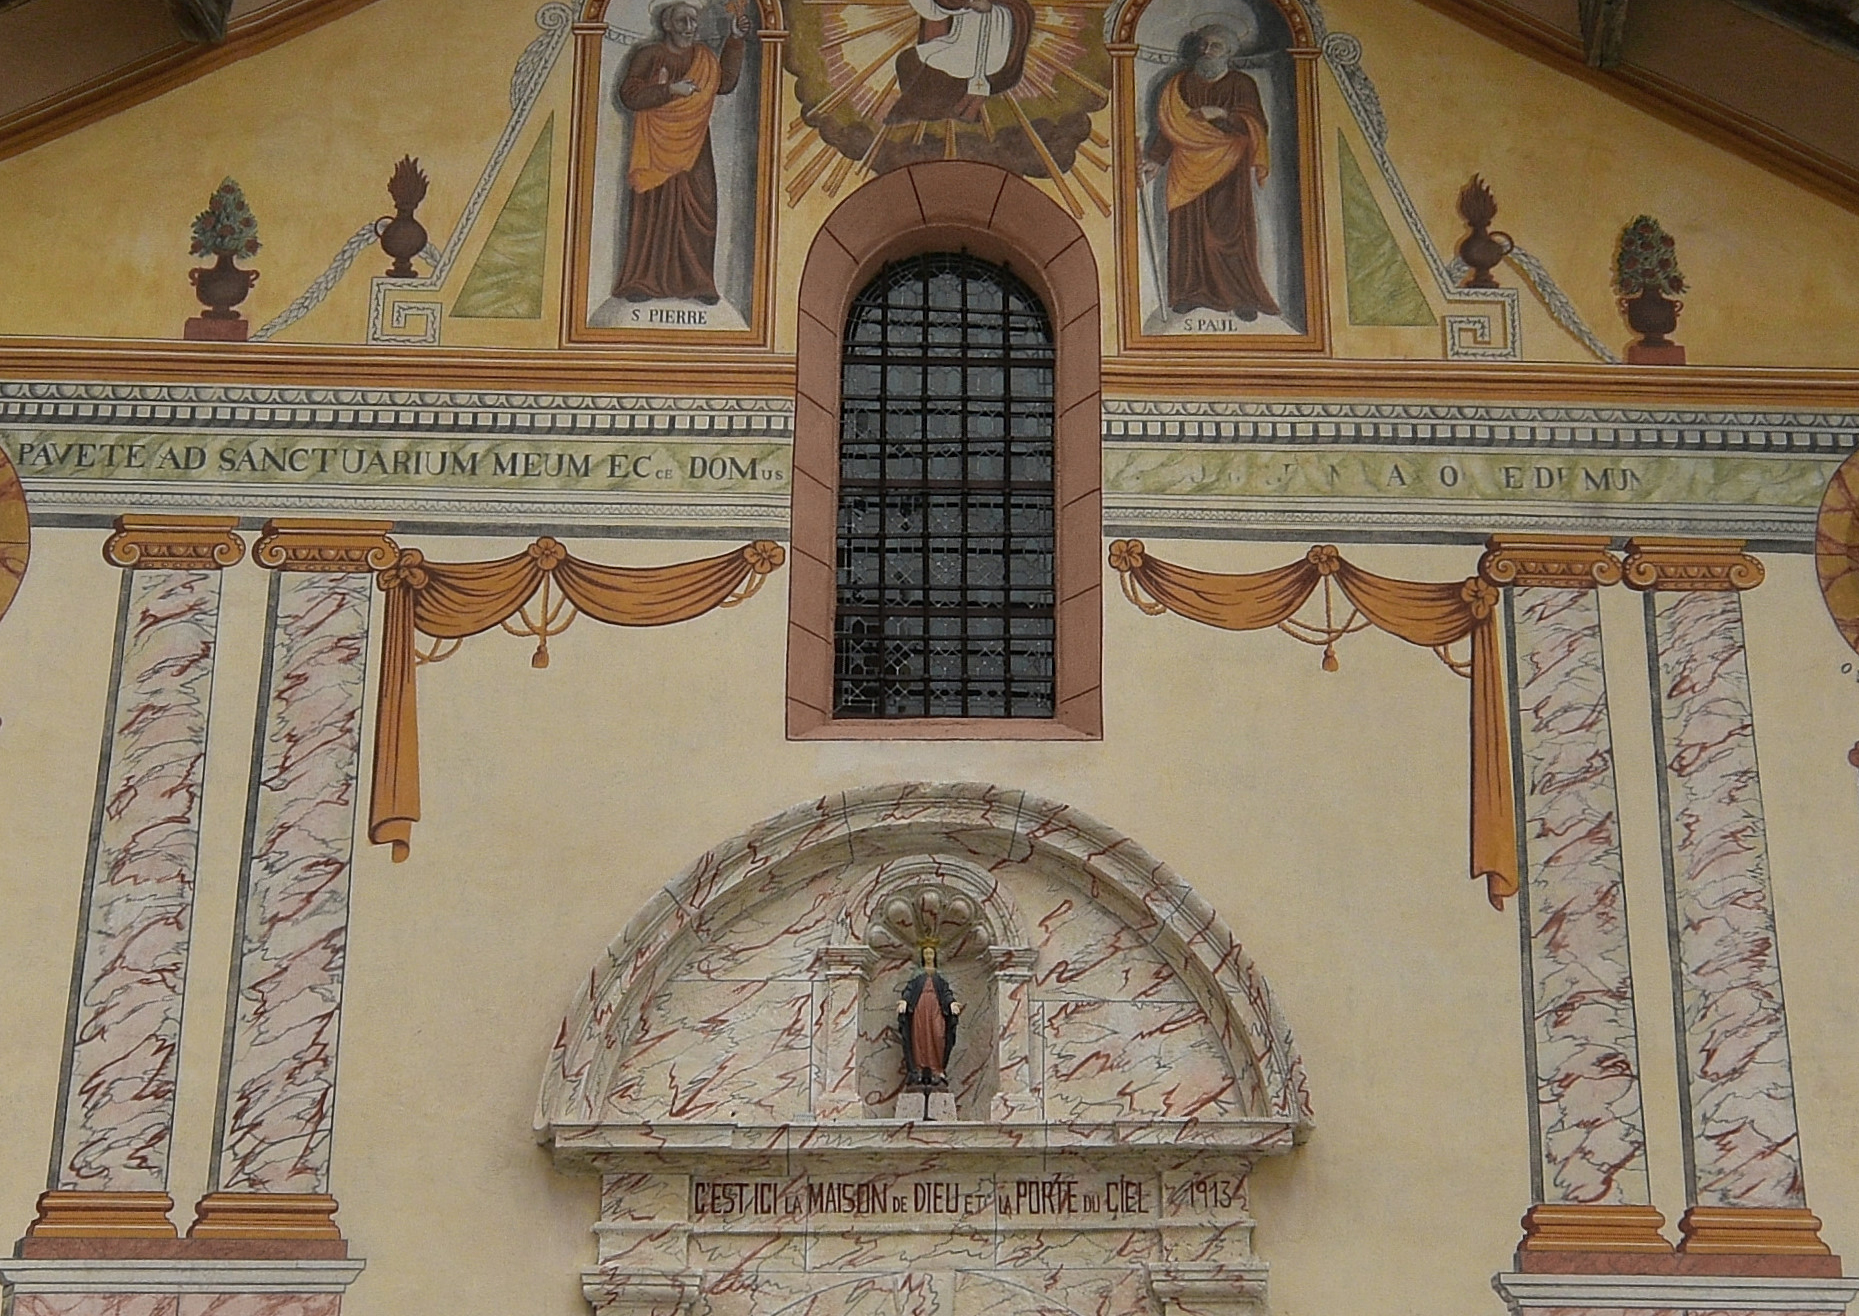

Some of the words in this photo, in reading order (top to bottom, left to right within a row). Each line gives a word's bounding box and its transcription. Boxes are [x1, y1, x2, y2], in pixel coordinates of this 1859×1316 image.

[631, 308, 641, 322] S
[649, 308, 708, 325] PIERRE
[1184, 318, 1193, 332] S
[1198, 318, 1238, 332] PAUL
[17, 442, 146, 469] PAVETE
[156, 445, 207, 471] AD
[218, 447, 478, 476] SANCTUARIUM
[491, 451, 591, 479] MEUM
[1840, 661, 1853, 675] O
[694, 1182, 750, 1215] C'EST
[754, 1182, 779, 1215] ICI
[784, 1194, 803, 1215] LA
[808, 1182, 888, 1215] MAISON
[892, 1195, 908, 1214] DE
[914, 1182, 959, 1214] DIEU
[964, 1196, 984, 1214] ET
[998, 1195, 1012, 1215] LA
[1016, 1181, 1079, 1215] PORTE
[1083, 1196, 1100, 1214] DU
[1106, 1180, 1150, 1215] CIEL
